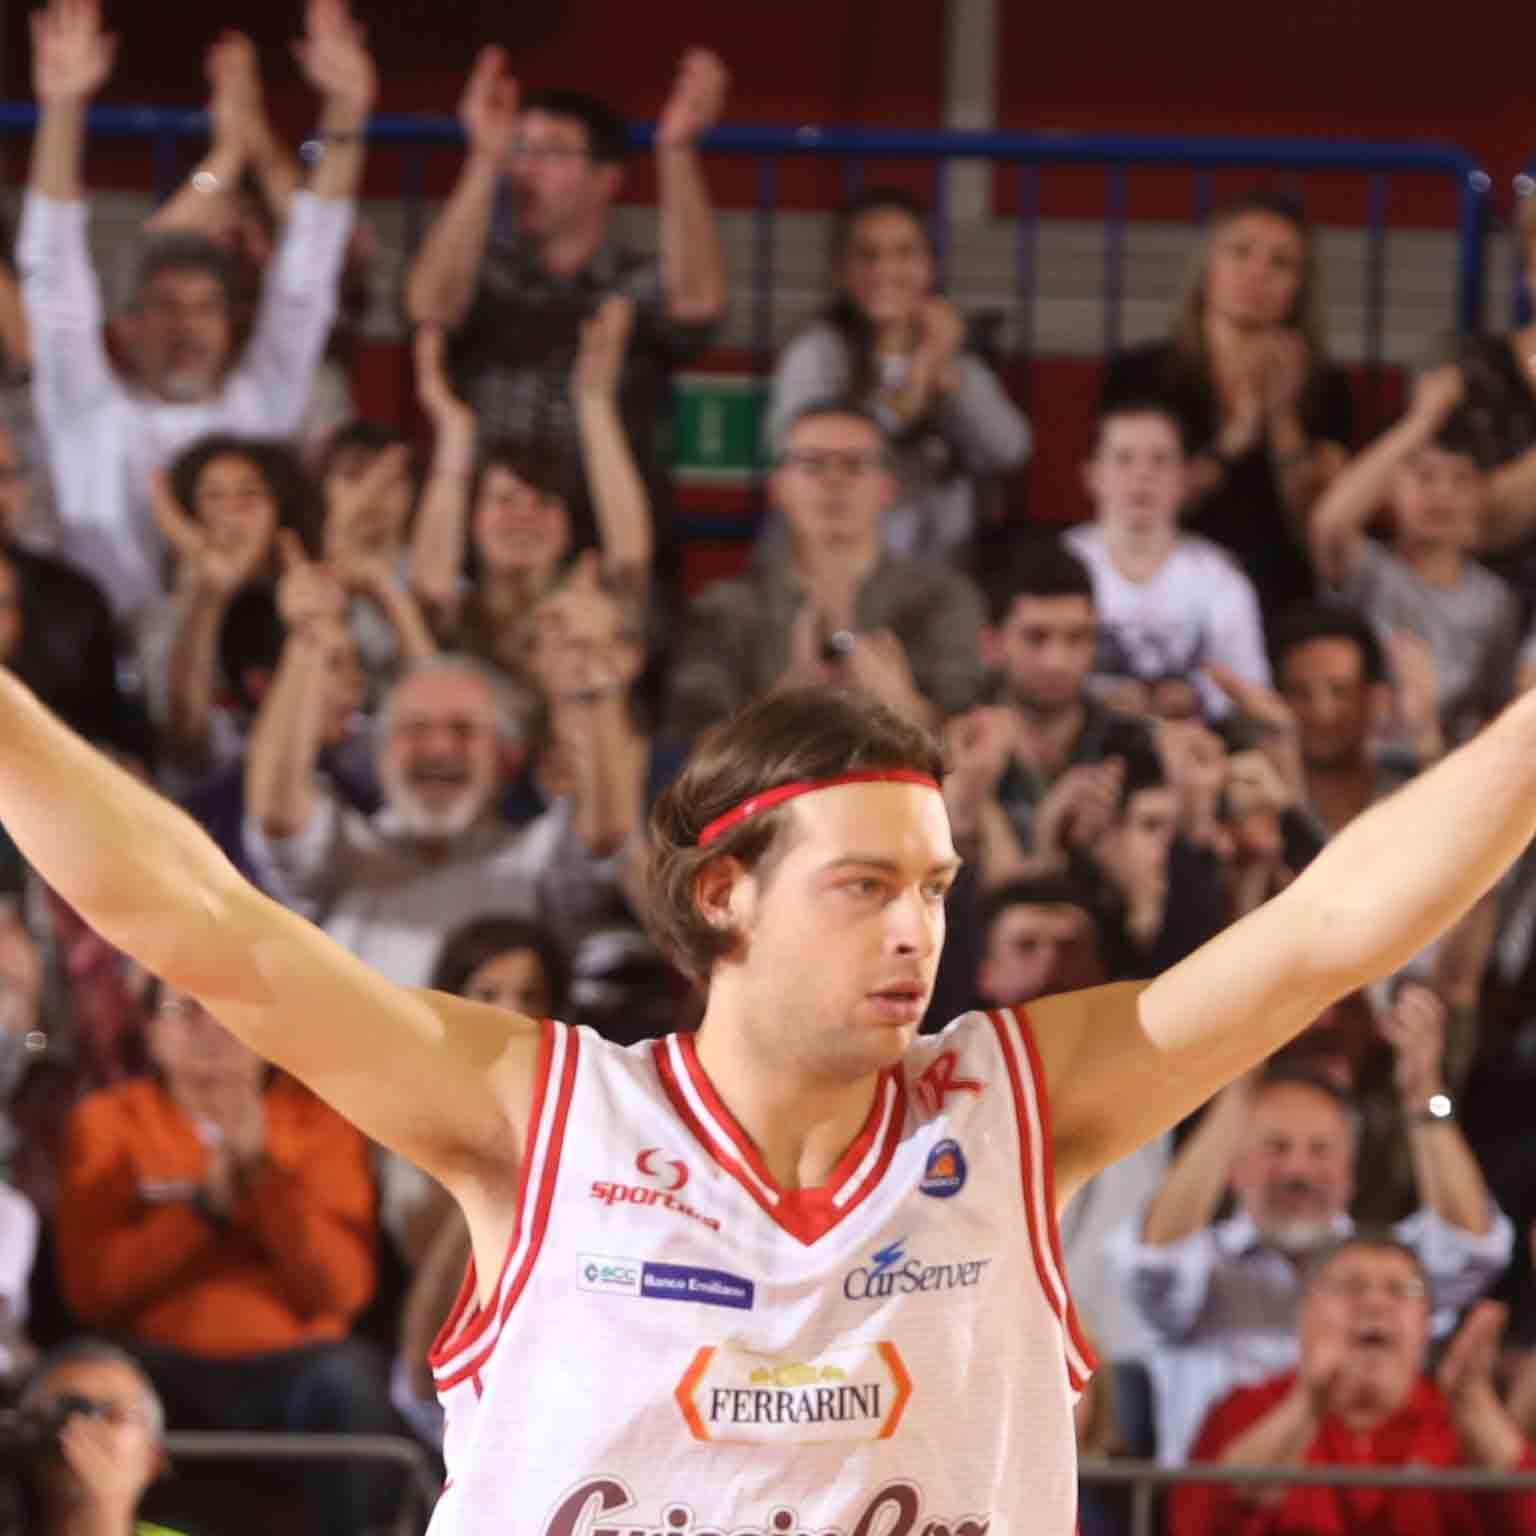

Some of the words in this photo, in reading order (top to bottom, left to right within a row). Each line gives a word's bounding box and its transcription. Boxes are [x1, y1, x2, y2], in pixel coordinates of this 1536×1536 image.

[589, 1179, 722, 1231] sporta
[642, 1272, 686, 1290] Banco
[686, 1277, 747, 1298] Emiliano
[843, 1256, 992, 1302] CarServer
[709, 1385, 882, 1427] FERRARINI
